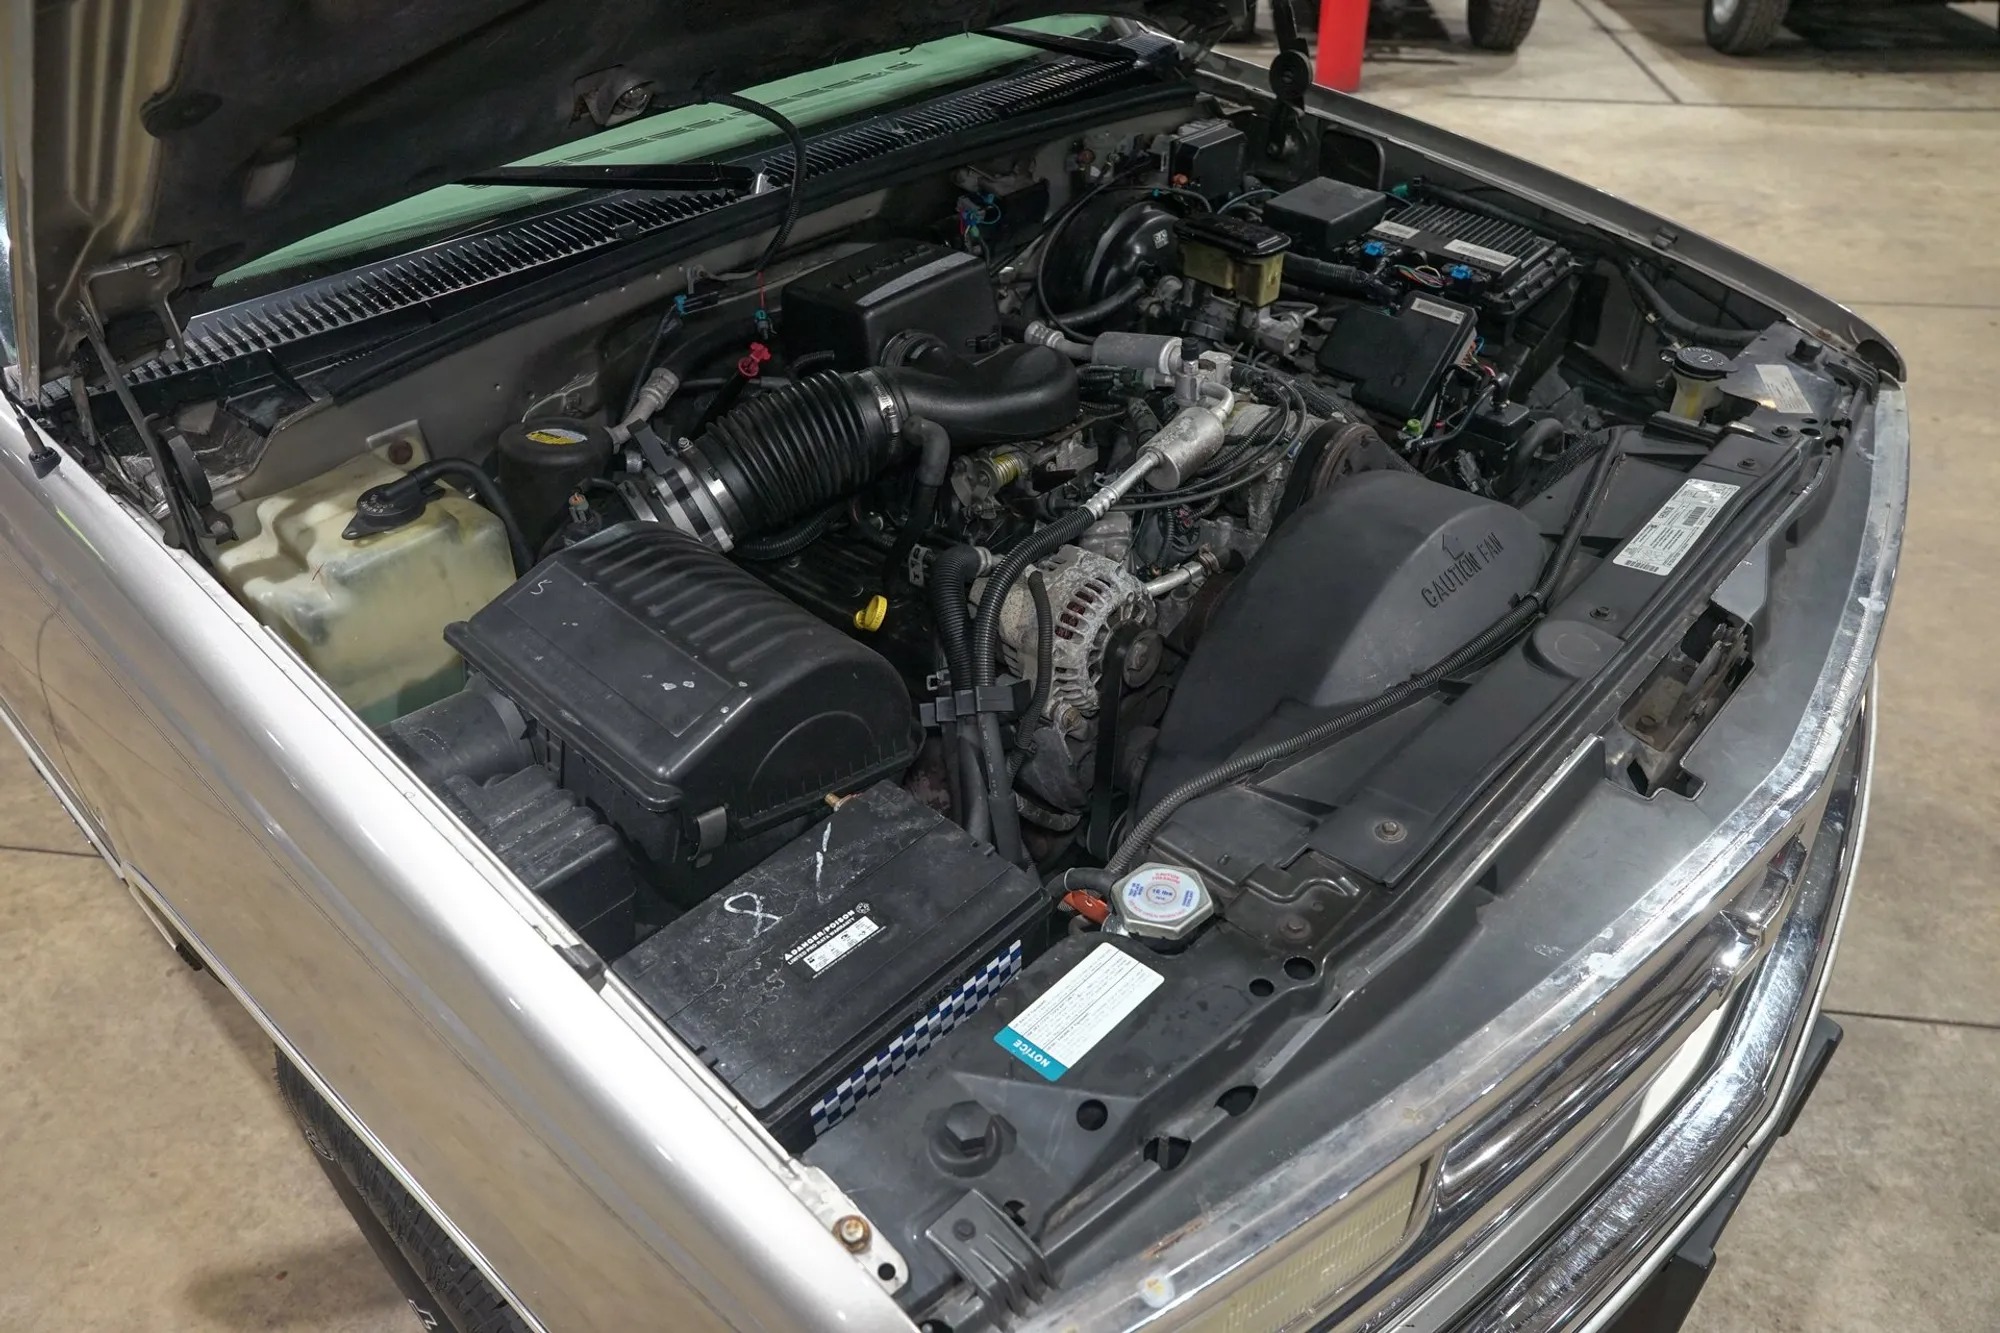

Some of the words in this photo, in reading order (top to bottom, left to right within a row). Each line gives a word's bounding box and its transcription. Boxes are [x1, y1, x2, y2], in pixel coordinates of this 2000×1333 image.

[1421, 551, 1482, 608] CAUTION
[1476, 532, 1504, 564] FAN
[790, 909, 855, 955] DANGER/POISON
[829, 916, 855, 936] WARRANTY
[1013, 1039, 1051, 1068] NOTICE
